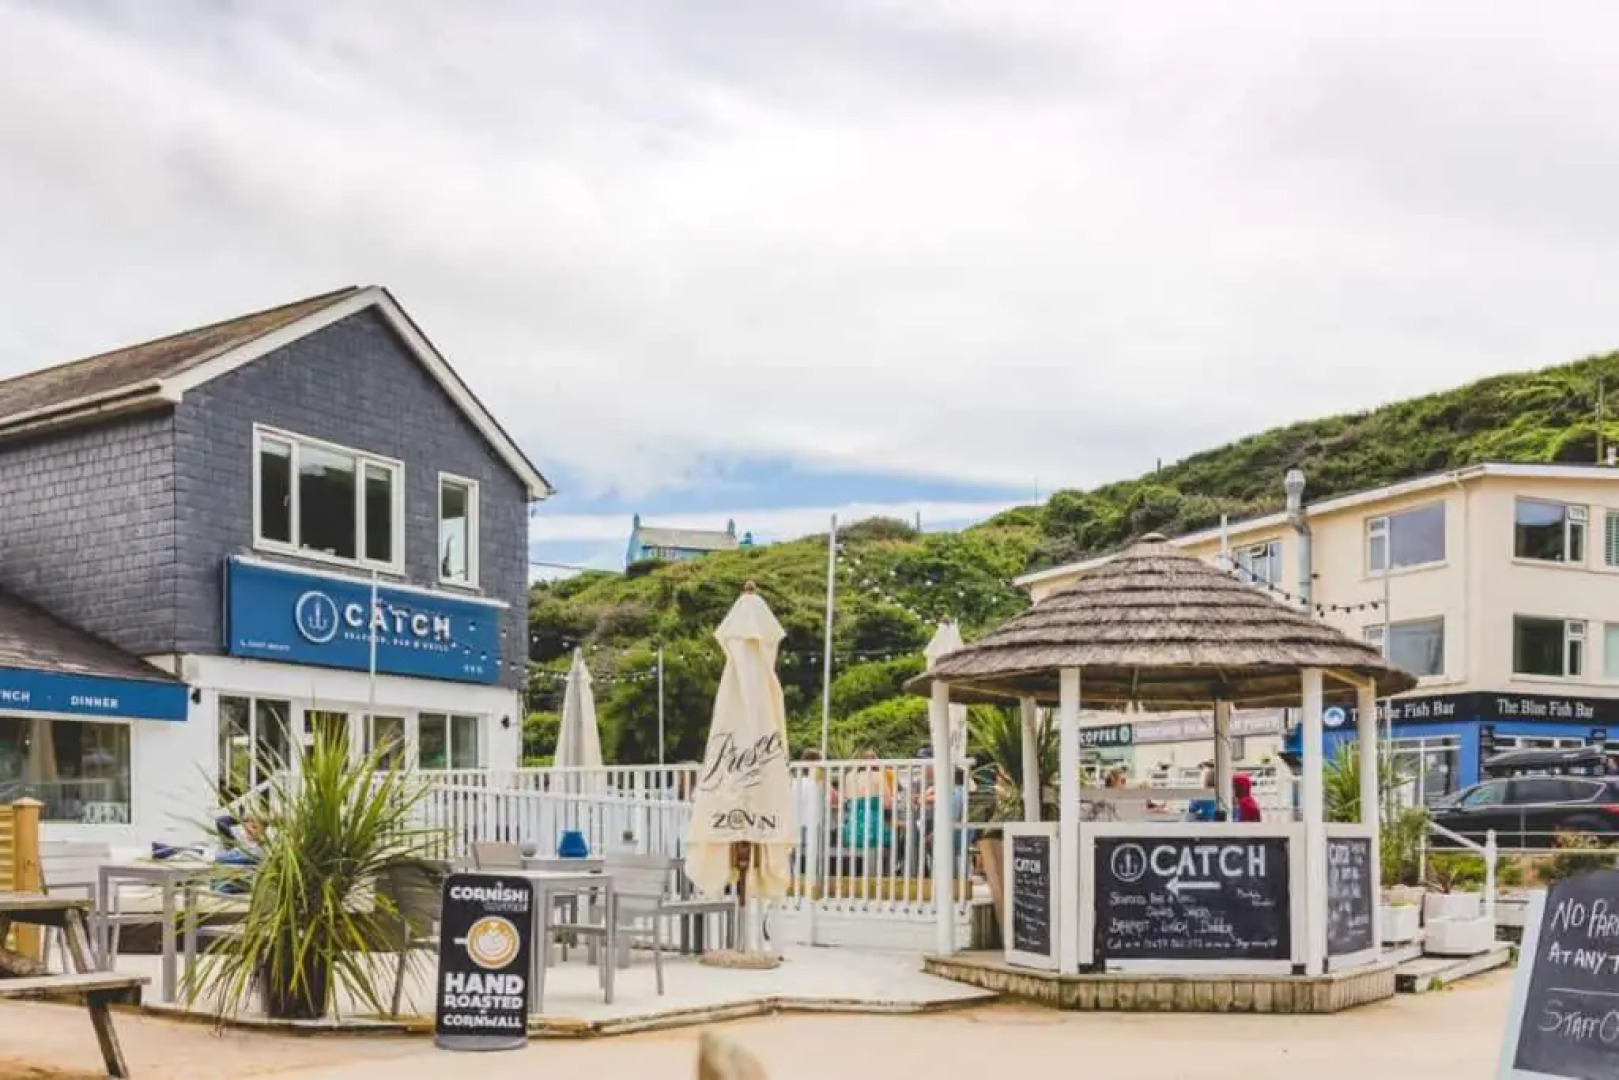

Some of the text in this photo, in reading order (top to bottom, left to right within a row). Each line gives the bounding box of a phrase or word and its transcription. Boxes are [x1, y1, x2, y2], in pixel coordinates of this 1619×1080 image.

[345, 602, 450, 640] CATCH
[0, 688, 120, 709] NCH DINNER
[1403, 701, 1431, 720] Fish
[1432, 700, 1456, 717] Bar
[1497, 697, 1595, 719] The Blue Fish Bar
[1151, 845, 1267, 877] CATCH
[1550, 898, 1619, 938] NO PAR
[1573, 947, 1608, 975] ANY
[444, 971, 525, 995] HAND
[443, 993, 524, 1010] ROASTED
[443, 1014, 523, 1028] CORNWALL
